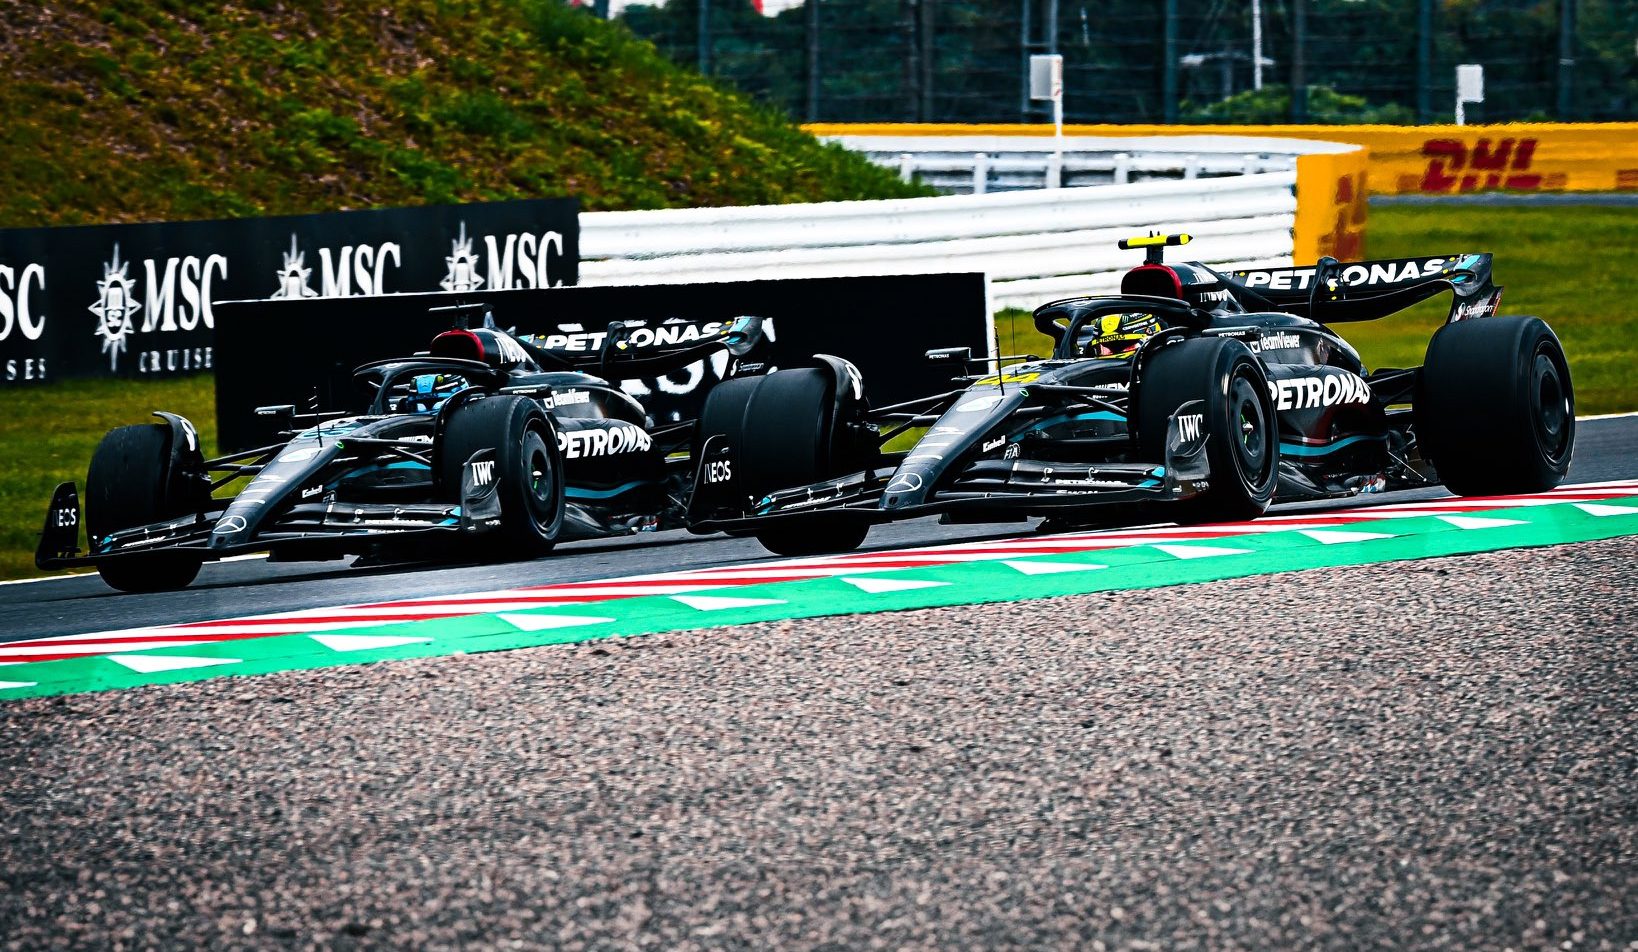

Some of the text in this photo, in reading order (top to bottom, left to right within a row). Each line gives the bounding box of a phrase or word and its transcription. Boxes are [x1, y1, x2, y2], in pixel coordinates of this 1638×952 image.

[1420, 137, 1542, 191] DHL
[318, 242, 400, 297] MSC
[484, 231, 563, 289] MSC
[1244, 258, 1446, 290] PETONAS
[141, 253, 227, 333] MSC
[543, 322, 723, 351] PETONAS
[1260, 332, 1300, 351] TeamViewer
[1178, 414, 1203, 442] IWC
[471, 461, 494, 486] IWC
